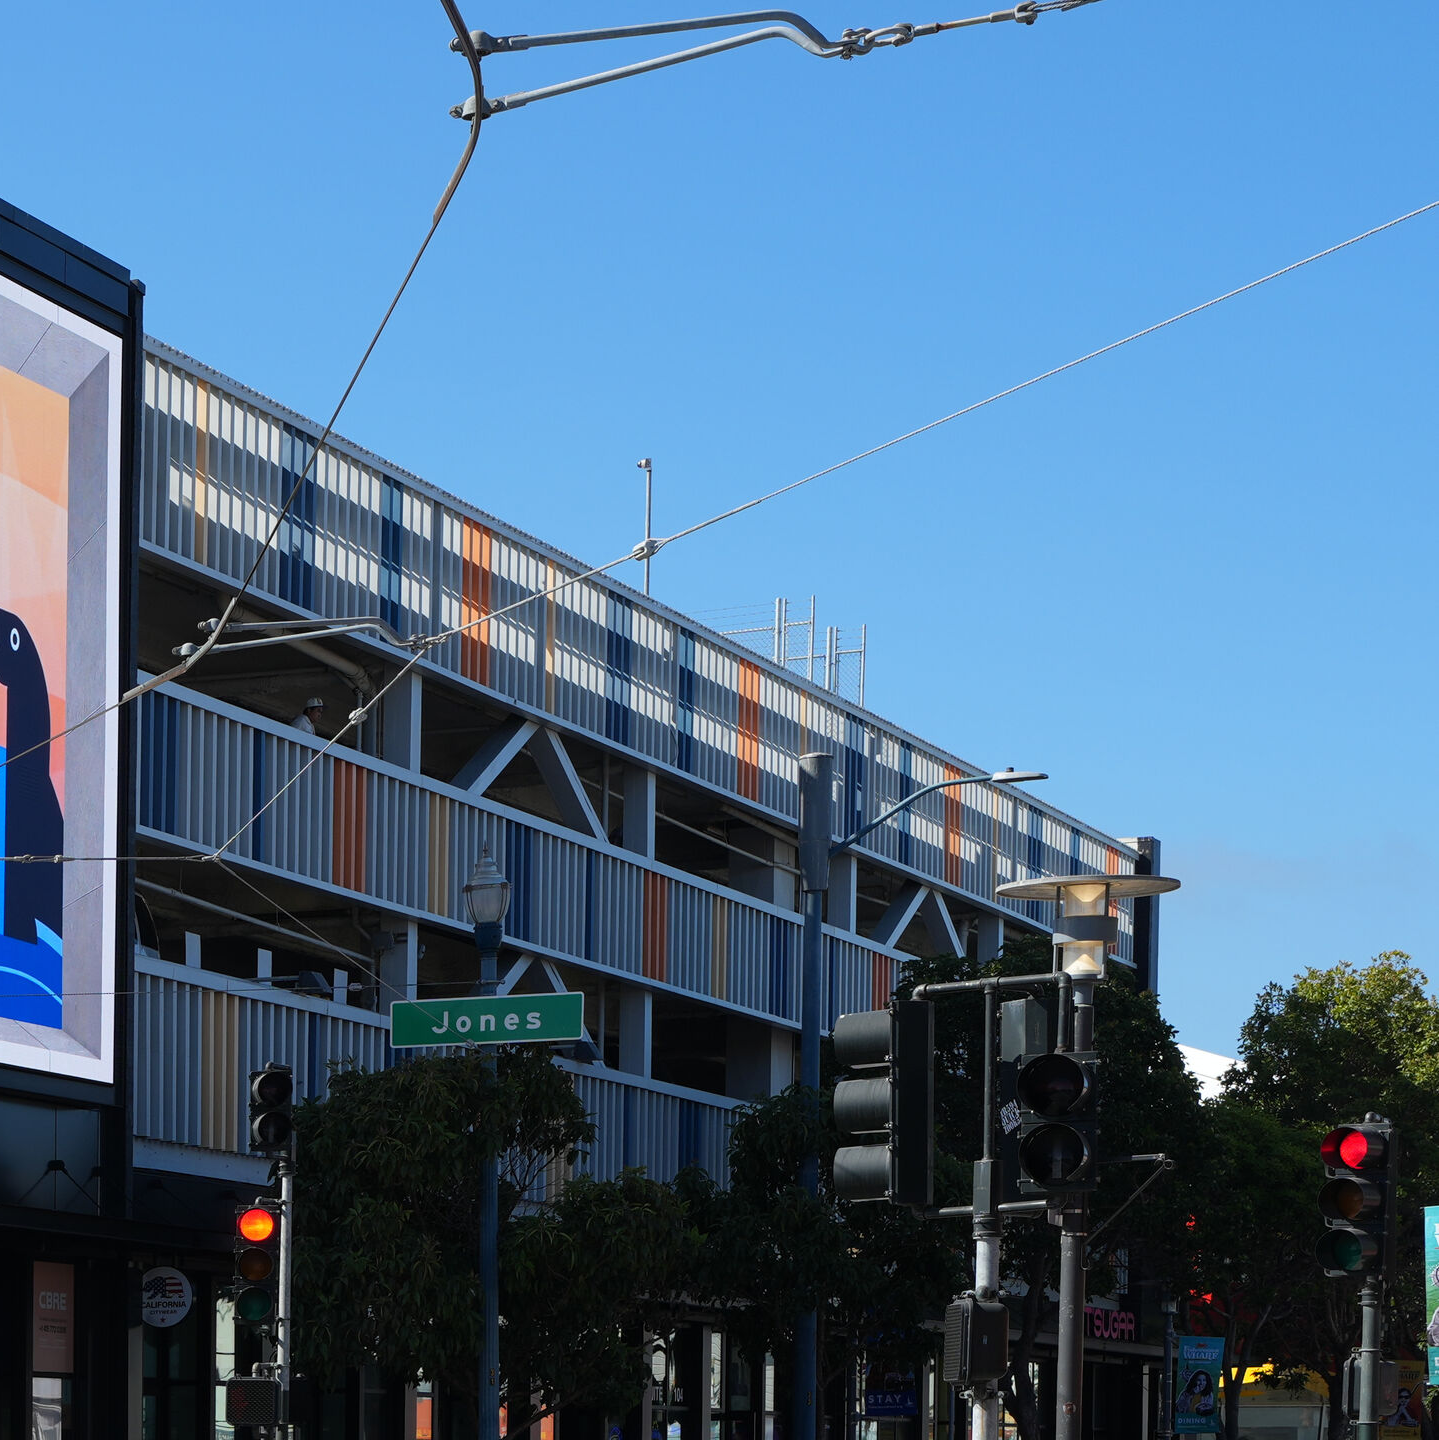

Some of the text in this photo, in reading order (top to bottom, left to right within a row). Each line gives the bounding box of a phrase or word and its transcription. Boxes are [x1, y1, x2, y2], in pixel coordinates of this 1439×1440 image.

[431, 1011, 543, 1035] Jones
[39, 1291, 68, 1311] CBRE
[868, 1394, 902, 1404] STAY
[1177, 1417, 1206, 1425] DINING
